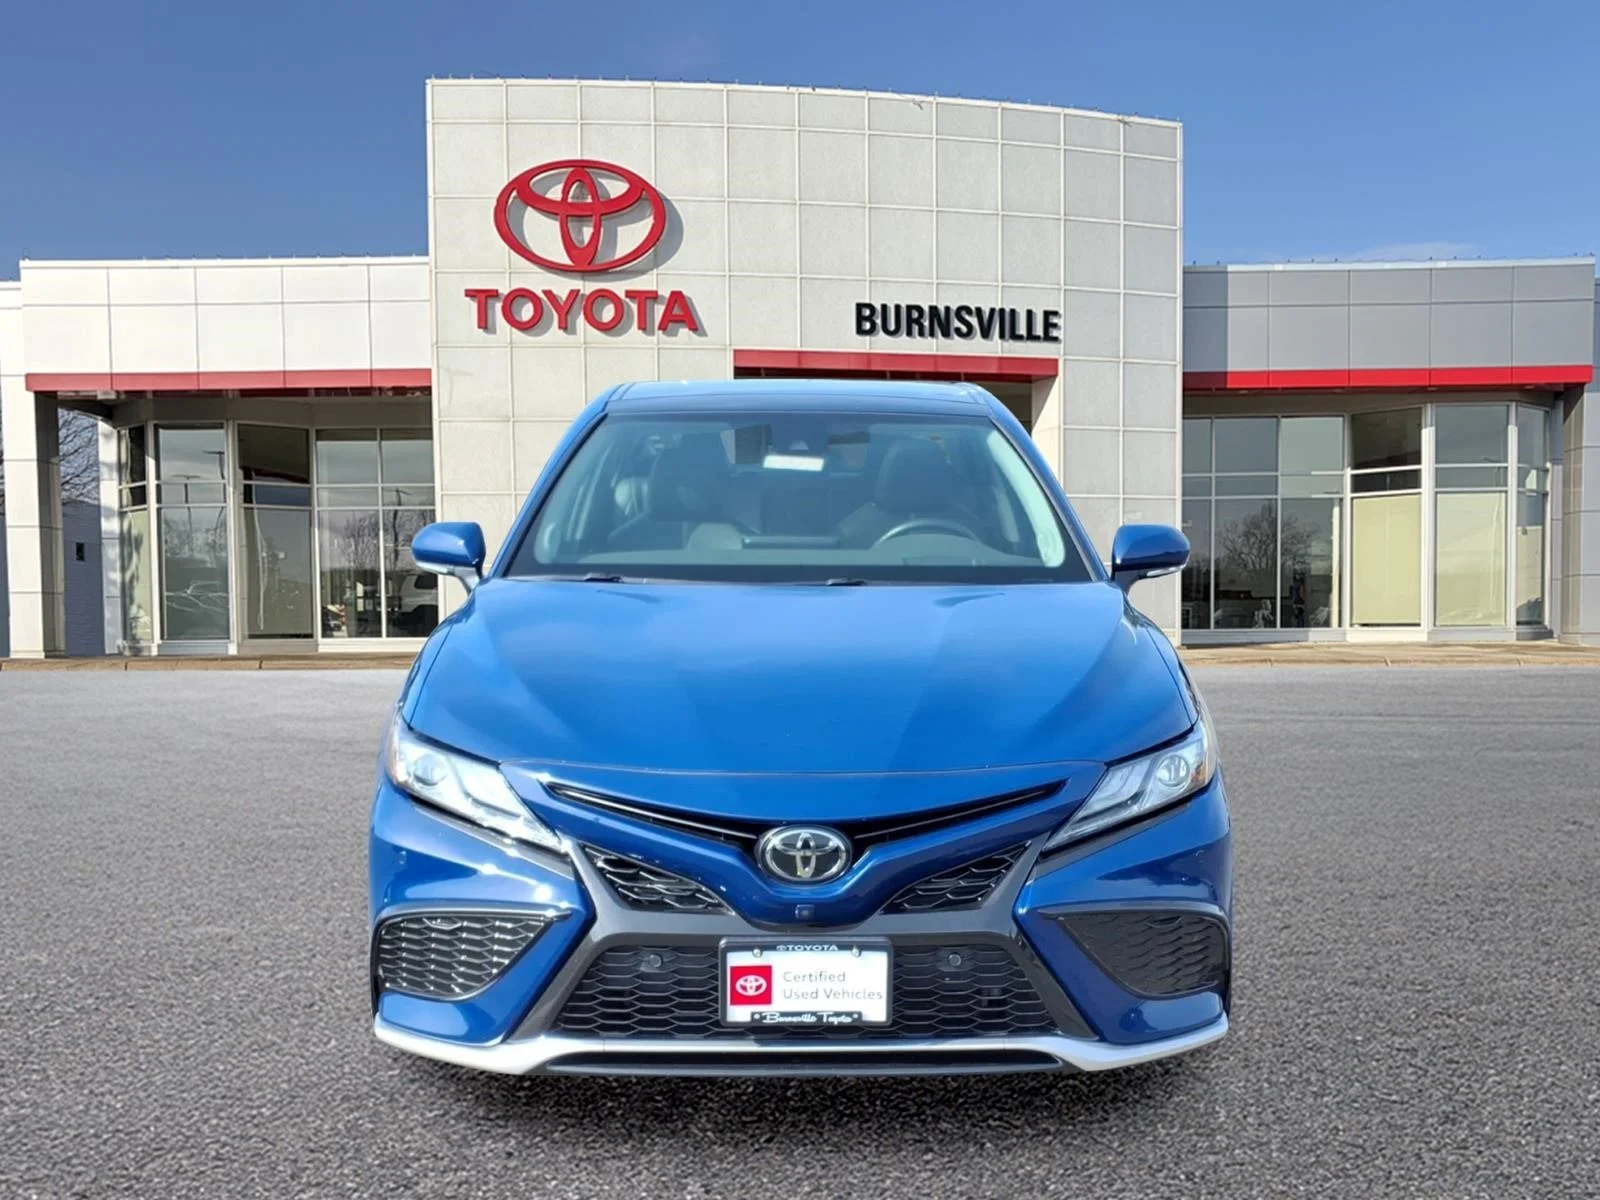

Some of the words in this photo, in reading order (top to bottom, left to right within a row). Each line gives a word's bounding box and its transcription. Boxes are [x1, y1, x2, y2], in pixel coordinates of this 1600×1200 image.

[464, 287, 699, 333] TOYOTA
[855, 302, 1062, 342] BURNSVILLE
[782, 971, 846, 983] Certified
[783, 988, 819, 1000] Used
[823, 988, 883, 1000] Vehicles
